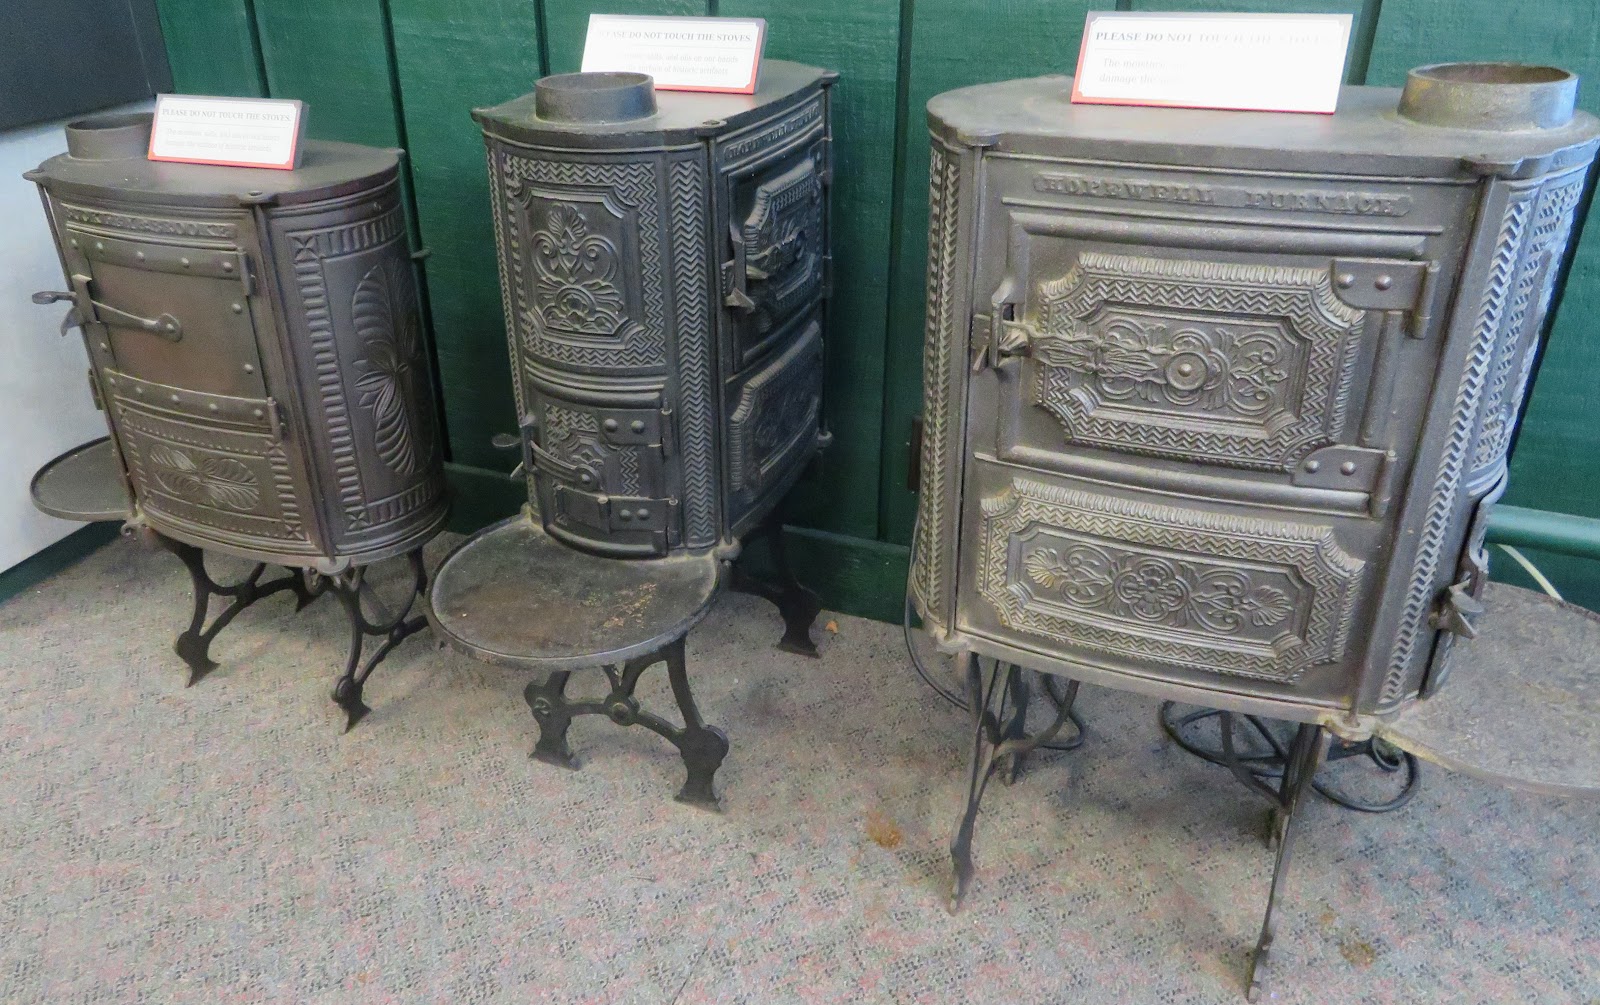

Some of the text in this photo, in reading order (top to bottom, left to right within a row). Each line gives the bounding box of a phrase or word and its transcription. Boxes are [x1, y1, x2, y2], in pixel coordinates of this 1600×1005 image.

[663, 32, 694, 40] TOUCH
[697, 33, 713, 41] THE
[1096, 32, 1141, 41] PLEASE
[1146, 32, 1163, 41] DO
[1167, 33, 1193, 42] NOT
[1103, 57, 1120, 67] The
[1099, 73, 1136, 85] damage
[162, 108, 187, 117] PLEASE
[1043, 177, 1396, 215] HOPEWELL FURNACE
